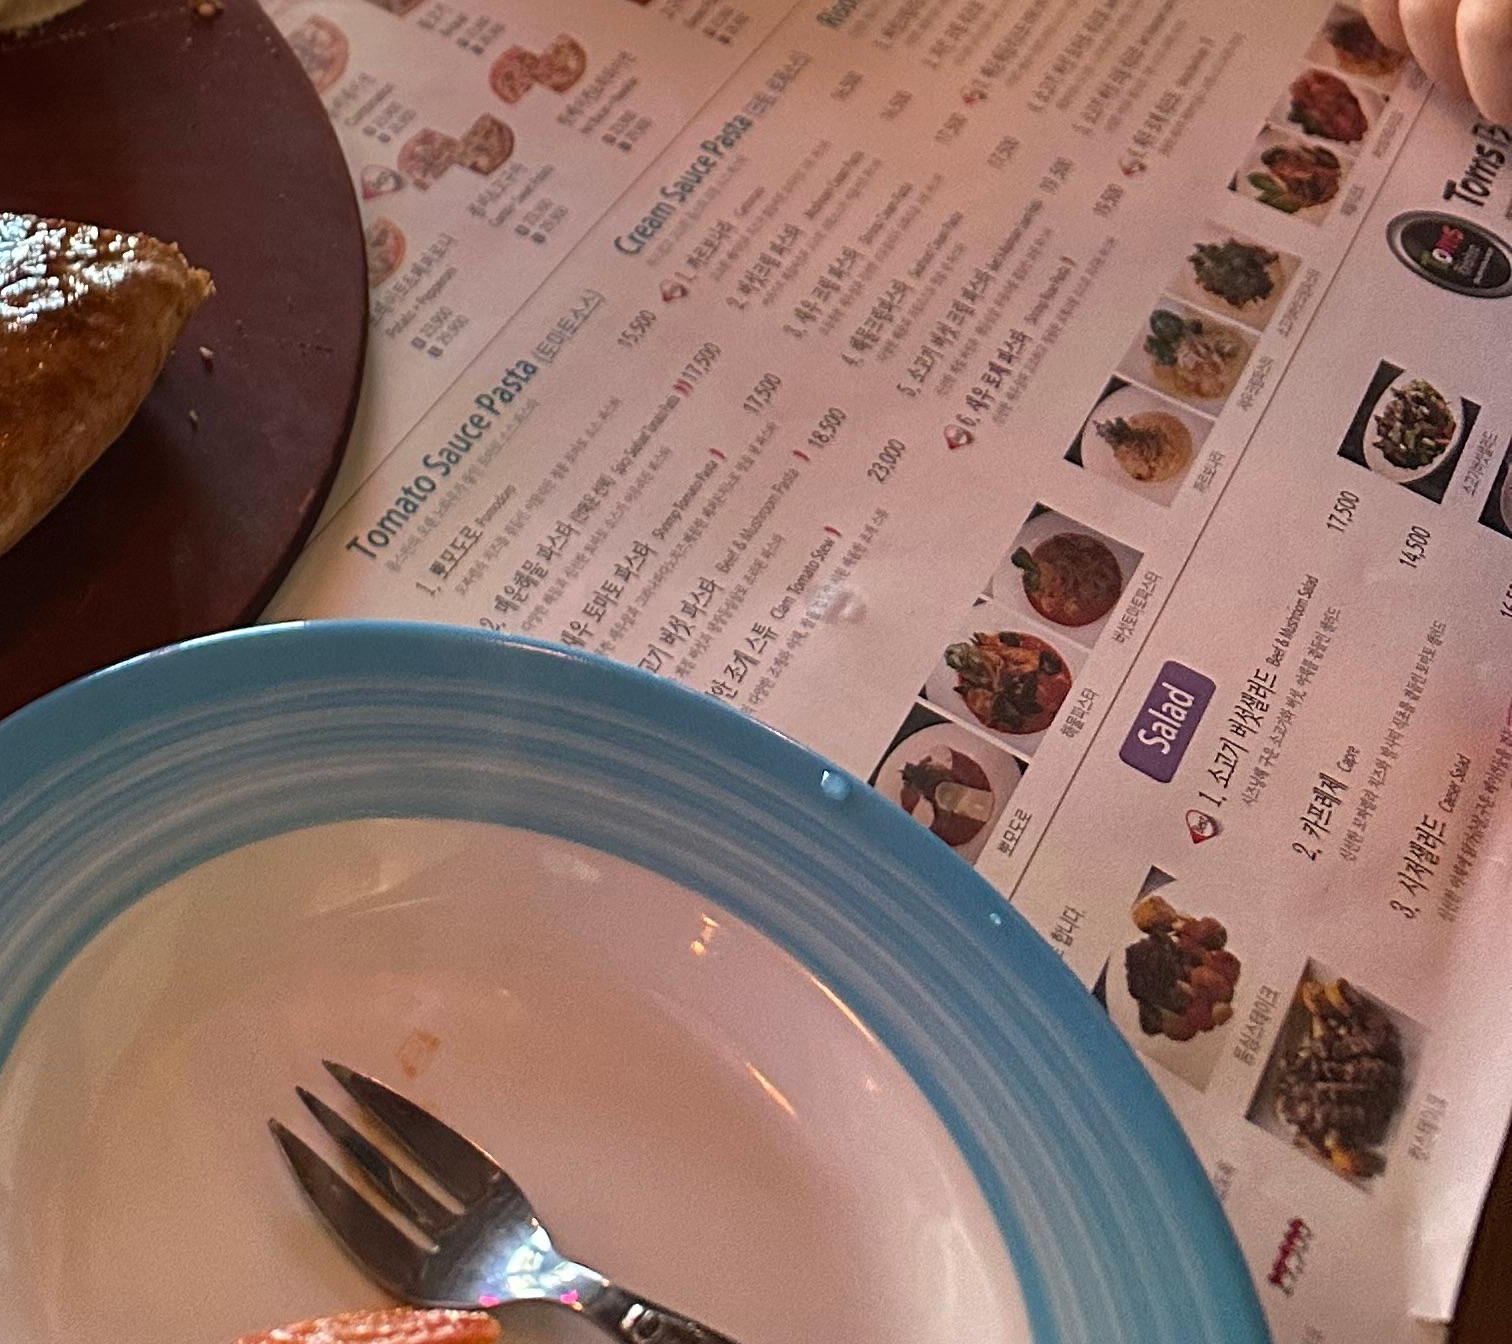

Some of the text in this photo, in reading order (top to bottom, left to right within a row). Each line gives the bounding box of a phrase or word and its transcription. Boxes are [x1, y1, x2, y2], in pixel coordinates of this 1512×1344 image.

[613, 202, 676, 257] Cream
[659, 155, 718, 204] Sauce
[700, 115, 754, 157] Pasta
[907, 344, 943, 384] 소고기
[997, 328, 1031, 365] 파스타
[955, 413, 981, 428] 6.
[965, 387, 995, 412] 새우
[344, 476, 436, 559] Tomato
[422, 413, 491, 477] Sauce
[475, 360, 538, 416] Pasta
[494, 560, 548, 613] 매운해물
[536, 520, 581, 563] 파스타
[682, 342, 721, 381] 17,500
[581, 580, 625, 624] 토마토
[614, 540, 657, 583] 파스타
[743, 373, 782, 414] 17,500
[1326, 490, 1360, 533] 17,500
[637, 643, 674, 679] 고기
[659, 614, 695, 647] 버섯
[680, 576, 725, 619] 파스타
[807, 407, 847, 449] 18,500
[723, 649, 760, 684] 조개
[745, 622, 778, 655] 스튜
[769, 595, 796, 621] Clam
[786, 560, 820, 595] Tomato
[810, 538, 835, 562] Stew
[867, 438, 906, 484] 23,000
[415, 581, 442, 598] 1.
[1112, 571, 1162, 644] 버섯토마토파스타
[1297, 574, 1319, 600] Salad
[1279, 598, 1308, 640] Mushroom
[1265, 645, 1285, 668] Beef
[1060, 688, 1099, 739] 해물파스타
[1138, 682, 1194, 754] Salad
[1228, 669, 1277, 738] 버섯샐러드
[1291, 525, 1431, 862] 2. 카프레제 Capre 14,500
[1207, 736, 1249, 789] 소고기
[1449, 752, 1472, 783] Salad
[1198, 791, 1228, 808] 1.
[997, 808, 1032, 857] 뽀모도로
[1398, 814, 1446, 896] 시저샐러드
[1050, 905, 1085, 947] 합니다.
[1389, 899, 1421, 920] 3.
[1233, 986, 1278, 1066] 등심스테이크
